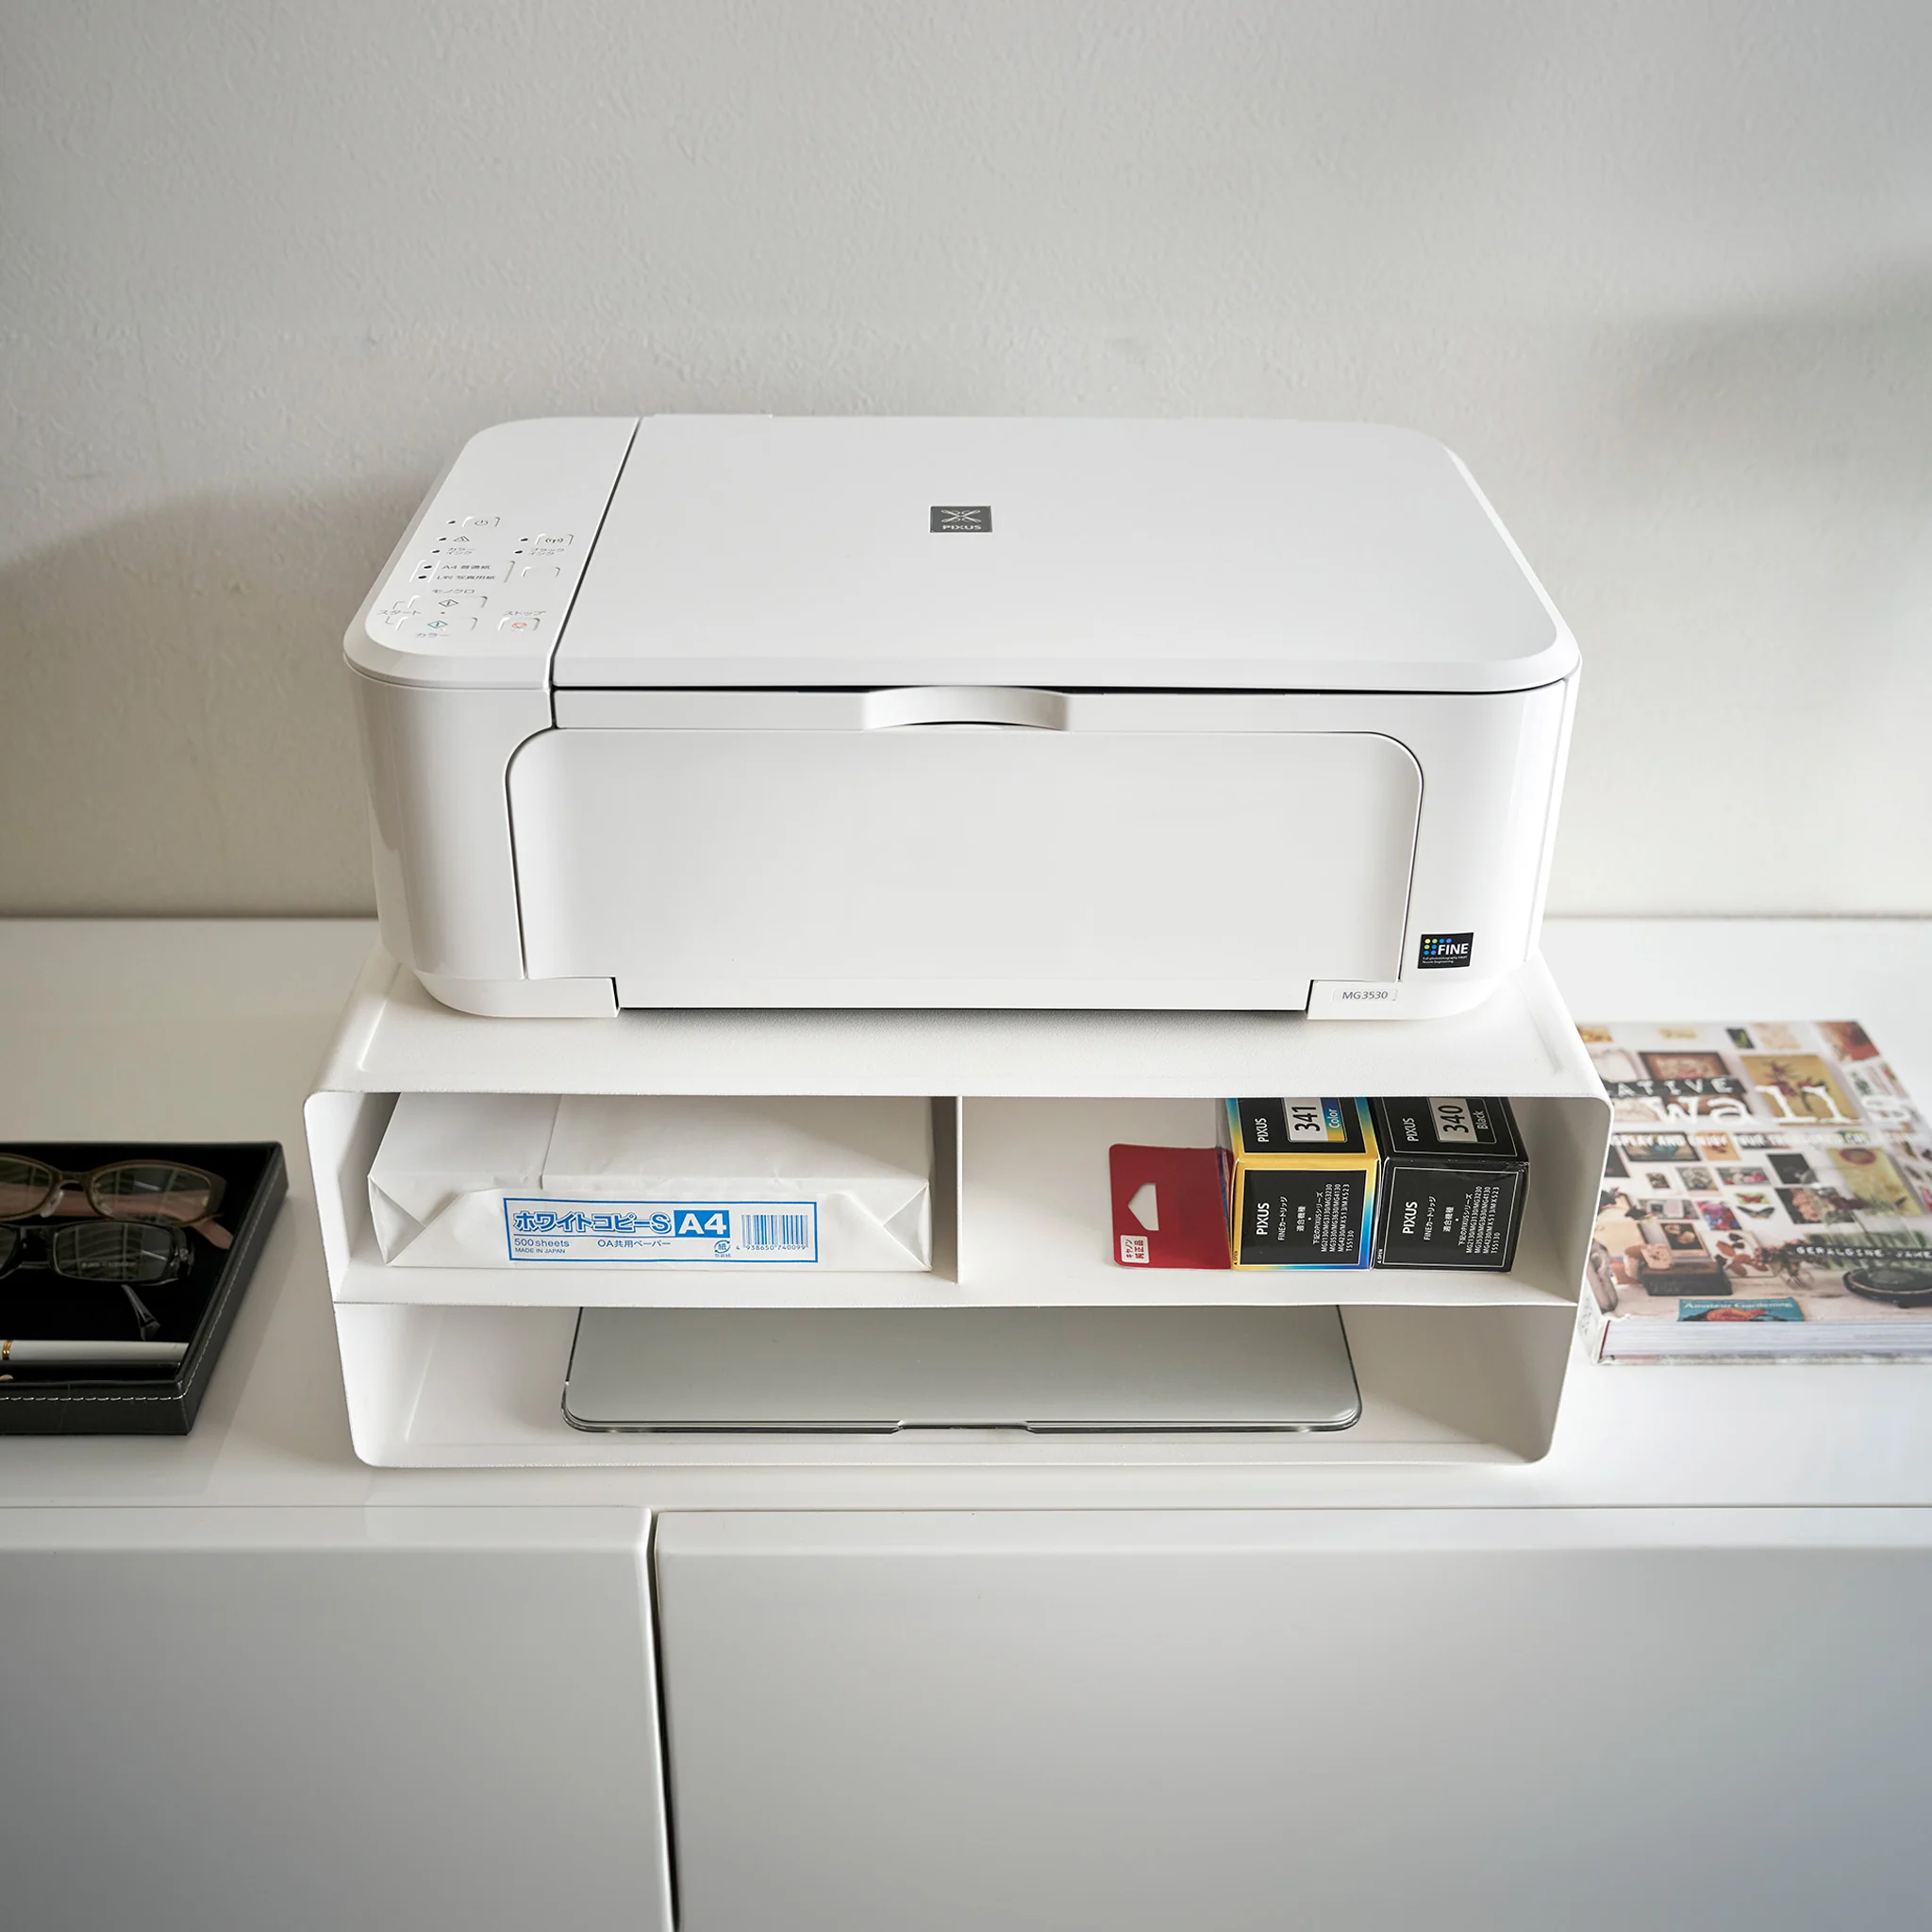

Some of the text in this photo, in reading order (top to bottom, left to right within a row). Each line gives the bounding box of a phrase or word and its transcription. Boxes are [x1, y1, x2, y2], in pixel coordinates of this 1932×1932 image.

[1438, 943, 1469, 956] FINE
[1341, 991, 1389, 1000] MG3530
[1608, 1077, 1733, 1096] ATIVE
[1255, 1118, 1269, 1142] PIXUS
[1291, 1107, 1320, 1131] 341
[1327, 1109, 1340, 1128] Color
[1403, 1118, 1419, 1141] PIXUS
[1438, 1106, 1469, 1133] 340
[1473, 1110, 1489, 1129] Black
[513, 1210, 726, 1235] ホワイトコピーS A4
[1257, 1203, 1270, 1235] PIXUS
[1277, 1196, 1288, 1241] FINEカートリッジ
[1402, 1201, 1418, 1234] PIXUS
[1424, 1196, 1437, 1241] FINEカートリッジ
